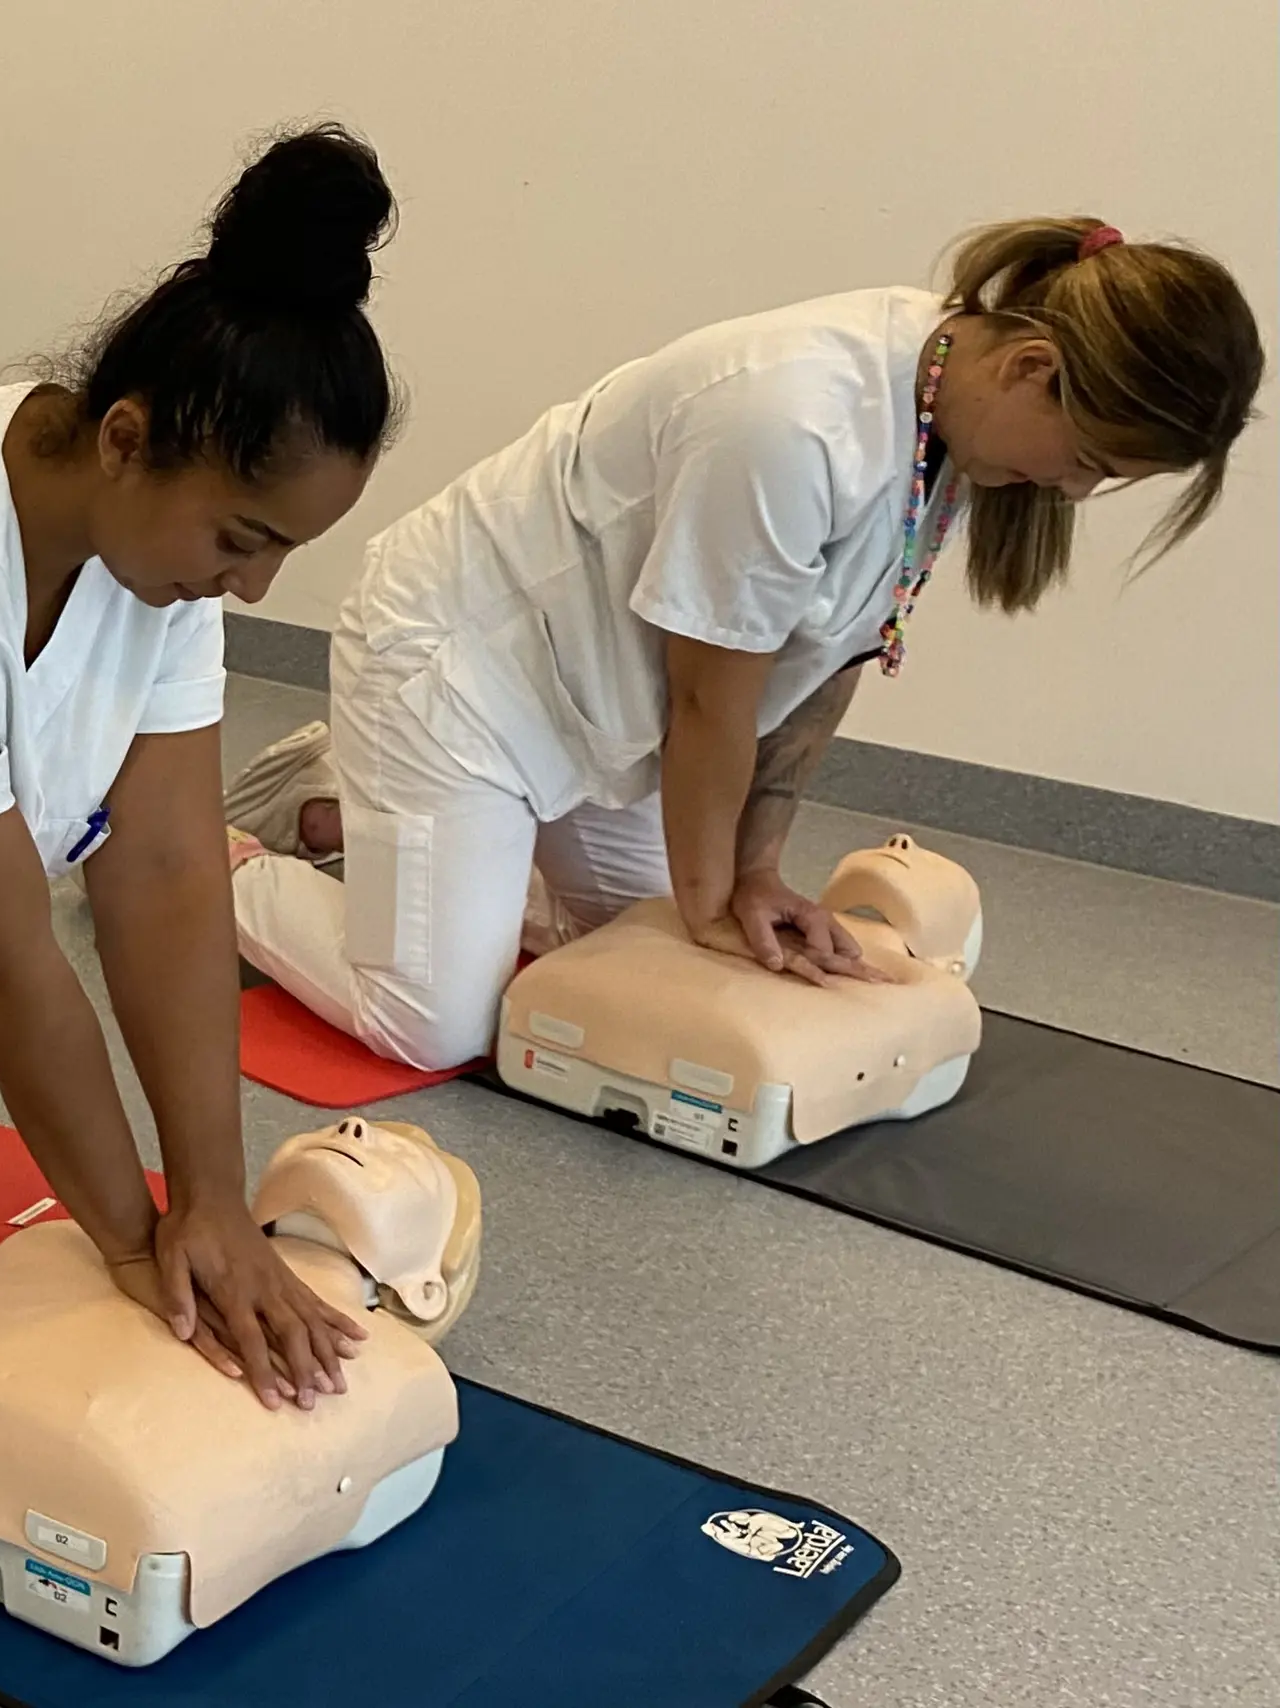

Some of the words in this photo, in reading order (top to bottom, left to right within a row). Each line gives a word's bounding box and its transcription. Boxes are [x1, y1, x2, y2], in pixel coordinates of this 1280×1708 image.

[55, 1533, 68, 1545] 02
[773, 1519, 843, 1577] Laerdal
[54, 1590, 67, 1603] 02
